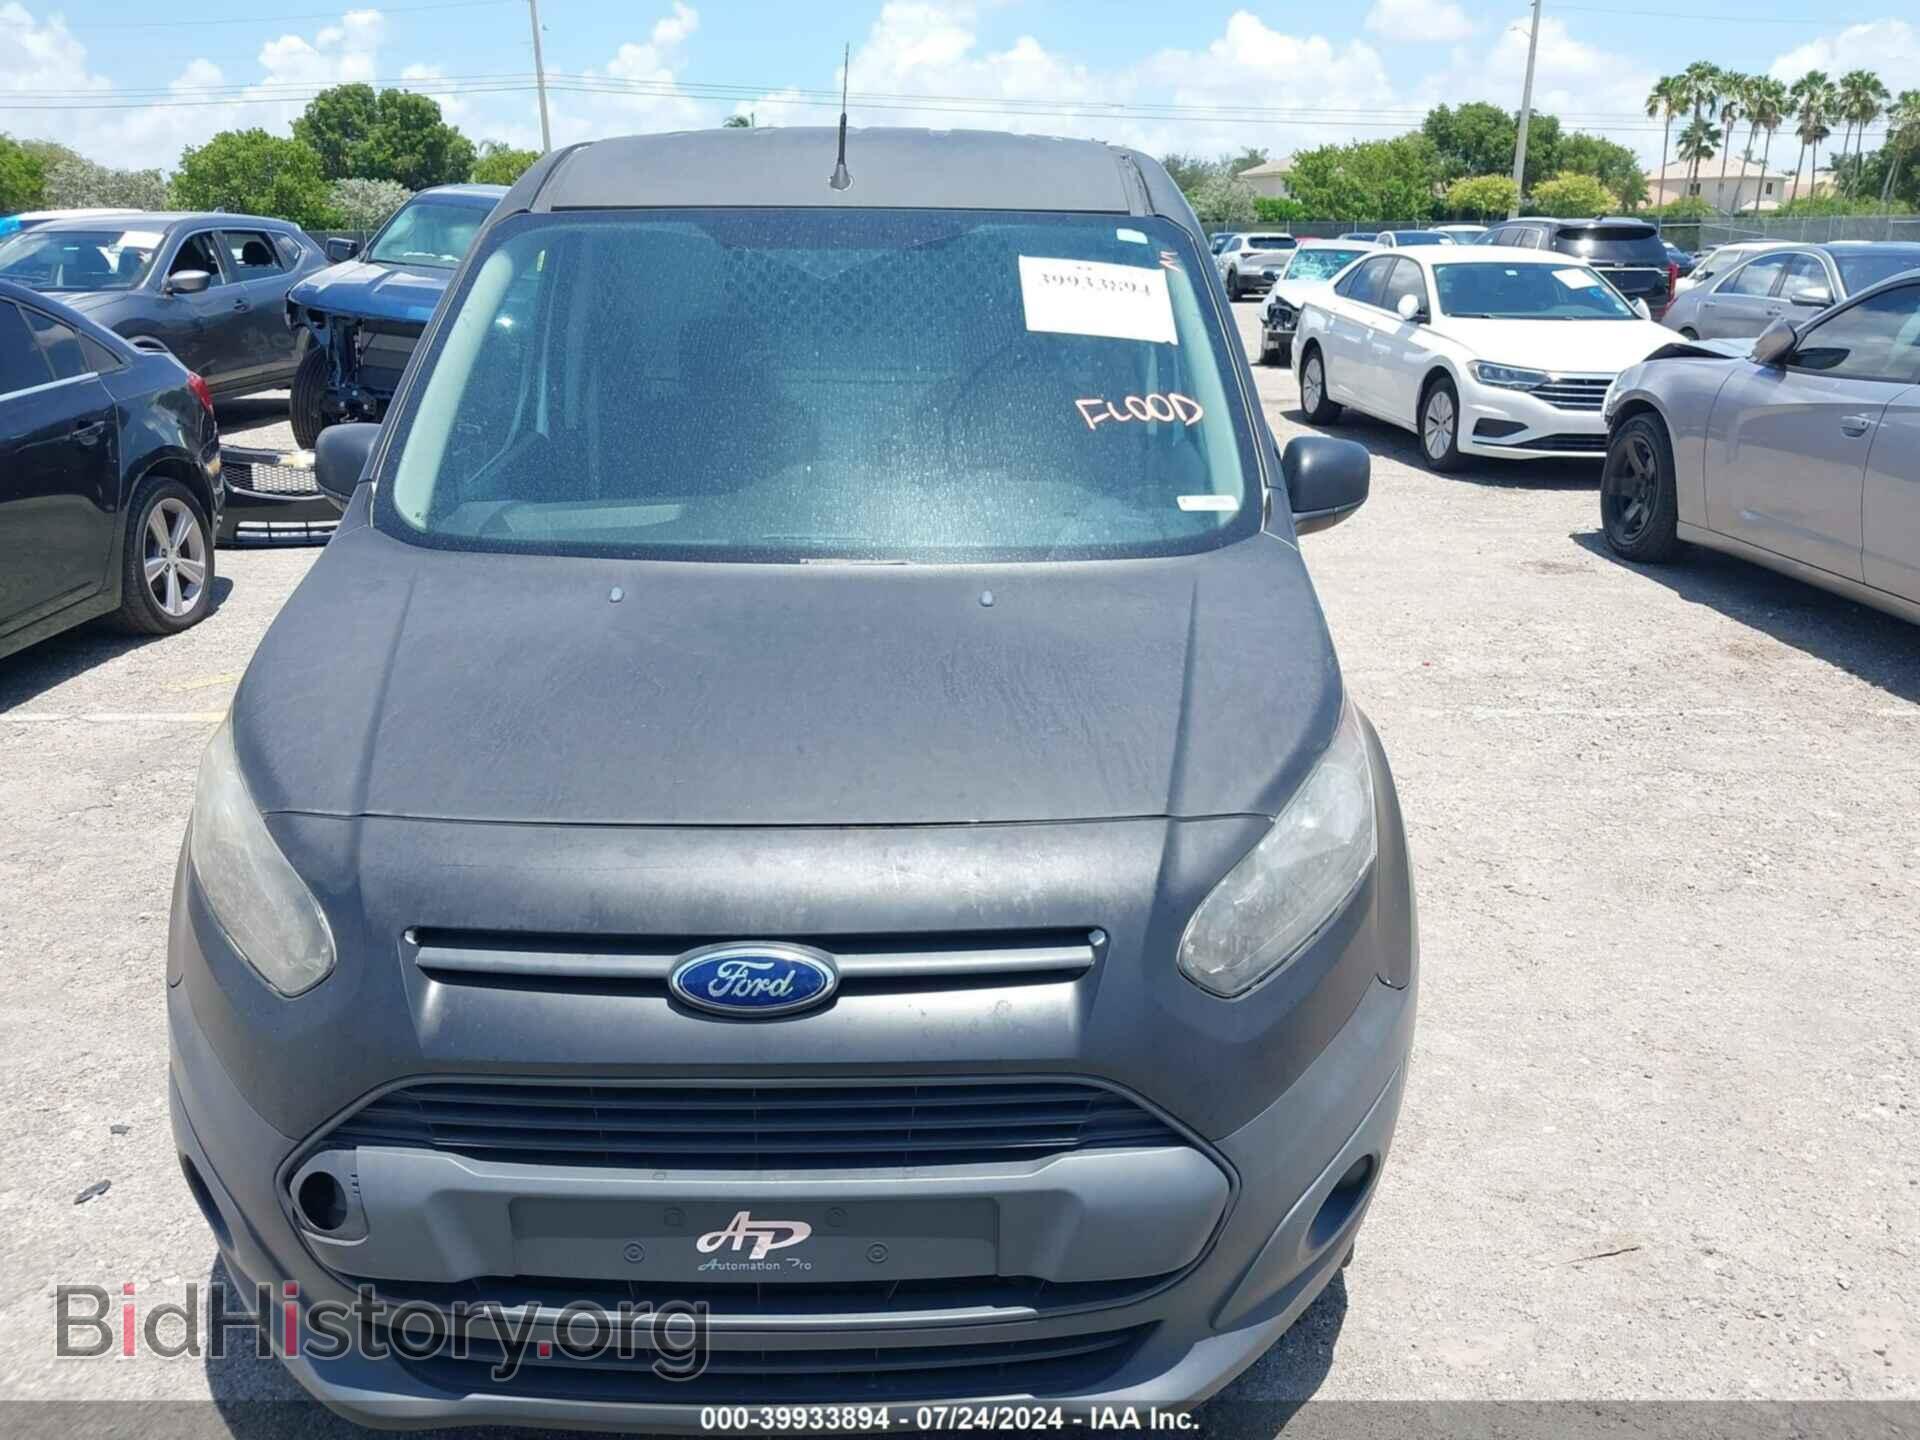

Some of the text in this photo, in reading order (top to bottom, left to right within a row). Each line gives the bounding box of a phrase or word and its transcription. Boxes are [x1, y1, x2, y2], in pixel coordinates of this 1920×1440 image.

[1074, 392, 1205, 430] FLOOD
[708, 960, 796, 997] Ford
[696, 1211, 812, 1260] AP
[698, 1259, 780, 1271] Automation
